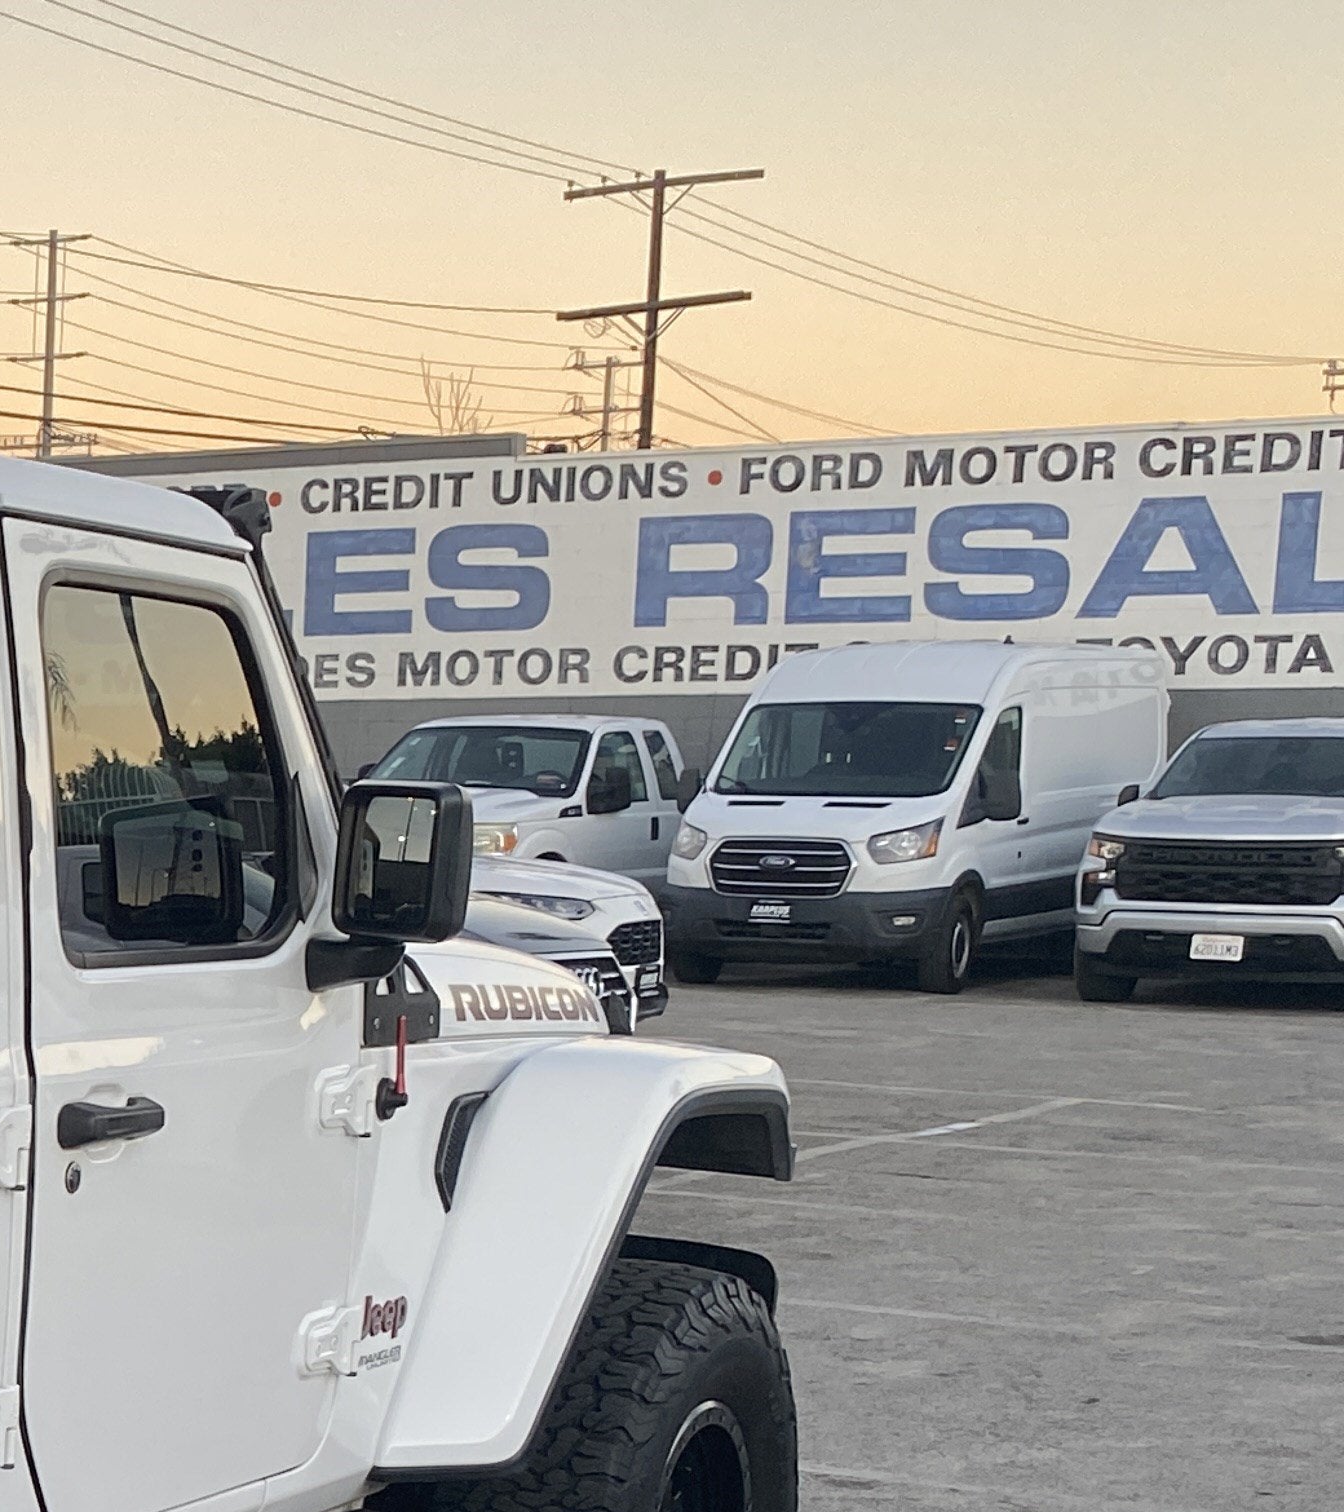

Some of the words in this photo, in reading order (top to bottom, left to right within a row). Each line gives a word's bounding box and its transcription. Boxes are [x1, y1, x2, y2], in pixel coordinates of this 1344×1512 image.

[300, 471, 474, 515] CREDIT
[492, 460, 689, 506] UNIONS
[739, 450, 883, 495] FORD
[904, 440, 1116, 488] MOTOR
[283, 523, 551, 637] ES
[633, 490, 1344, 628] RESAL
[397, 647, 590, 688] MOTOR
[448, 983, 601, 1022] RUBICON
[360, 1295, 408, 1340] Jeep
